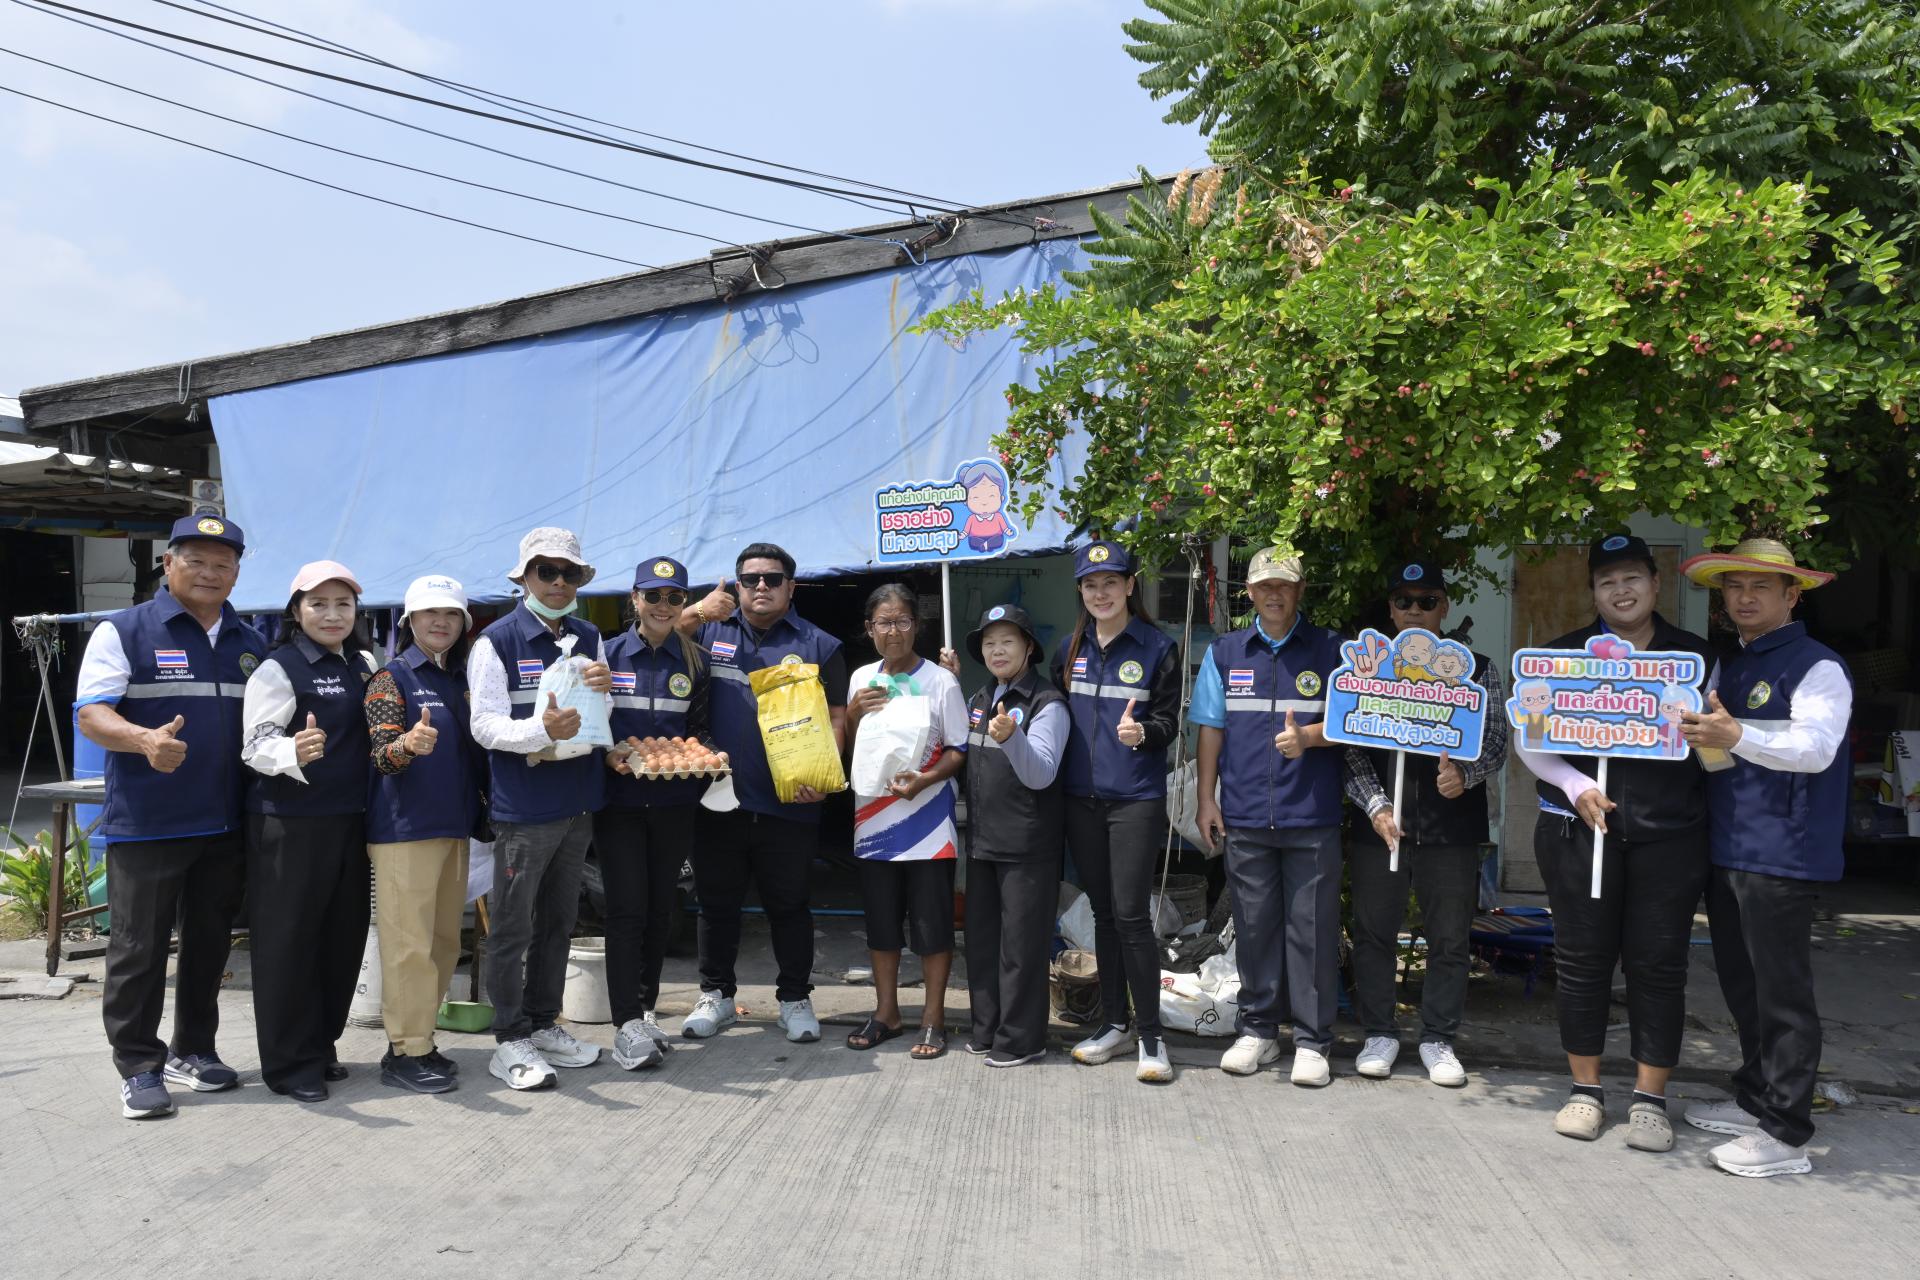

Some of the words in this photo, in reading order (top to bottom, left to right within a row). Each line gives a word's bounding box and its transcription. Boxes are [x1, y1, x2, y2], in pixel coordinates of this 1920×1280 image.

[880, 485, 965, 506] แก่อย่างมีคุณค่า
[882, 505, 953, 530] ชราอย่าง
[882, 530, 959, 554] มีความสุข
[1522, 656, 1694, 683] ขอมอบความสุข
[1336, 672, 1481, 711] ส่งมอบกำลังใจดีๆ
[1556, 685, 1656, 717] และสิ่งดีๆ
[1359, 696, 1452, 722] และสุขภาพ
[1346, 710, 1461, 746] ที่ดีให้ผู้สูงวัย
[1551, 715, 1658, 747] ให้ผู้สูงวัย
